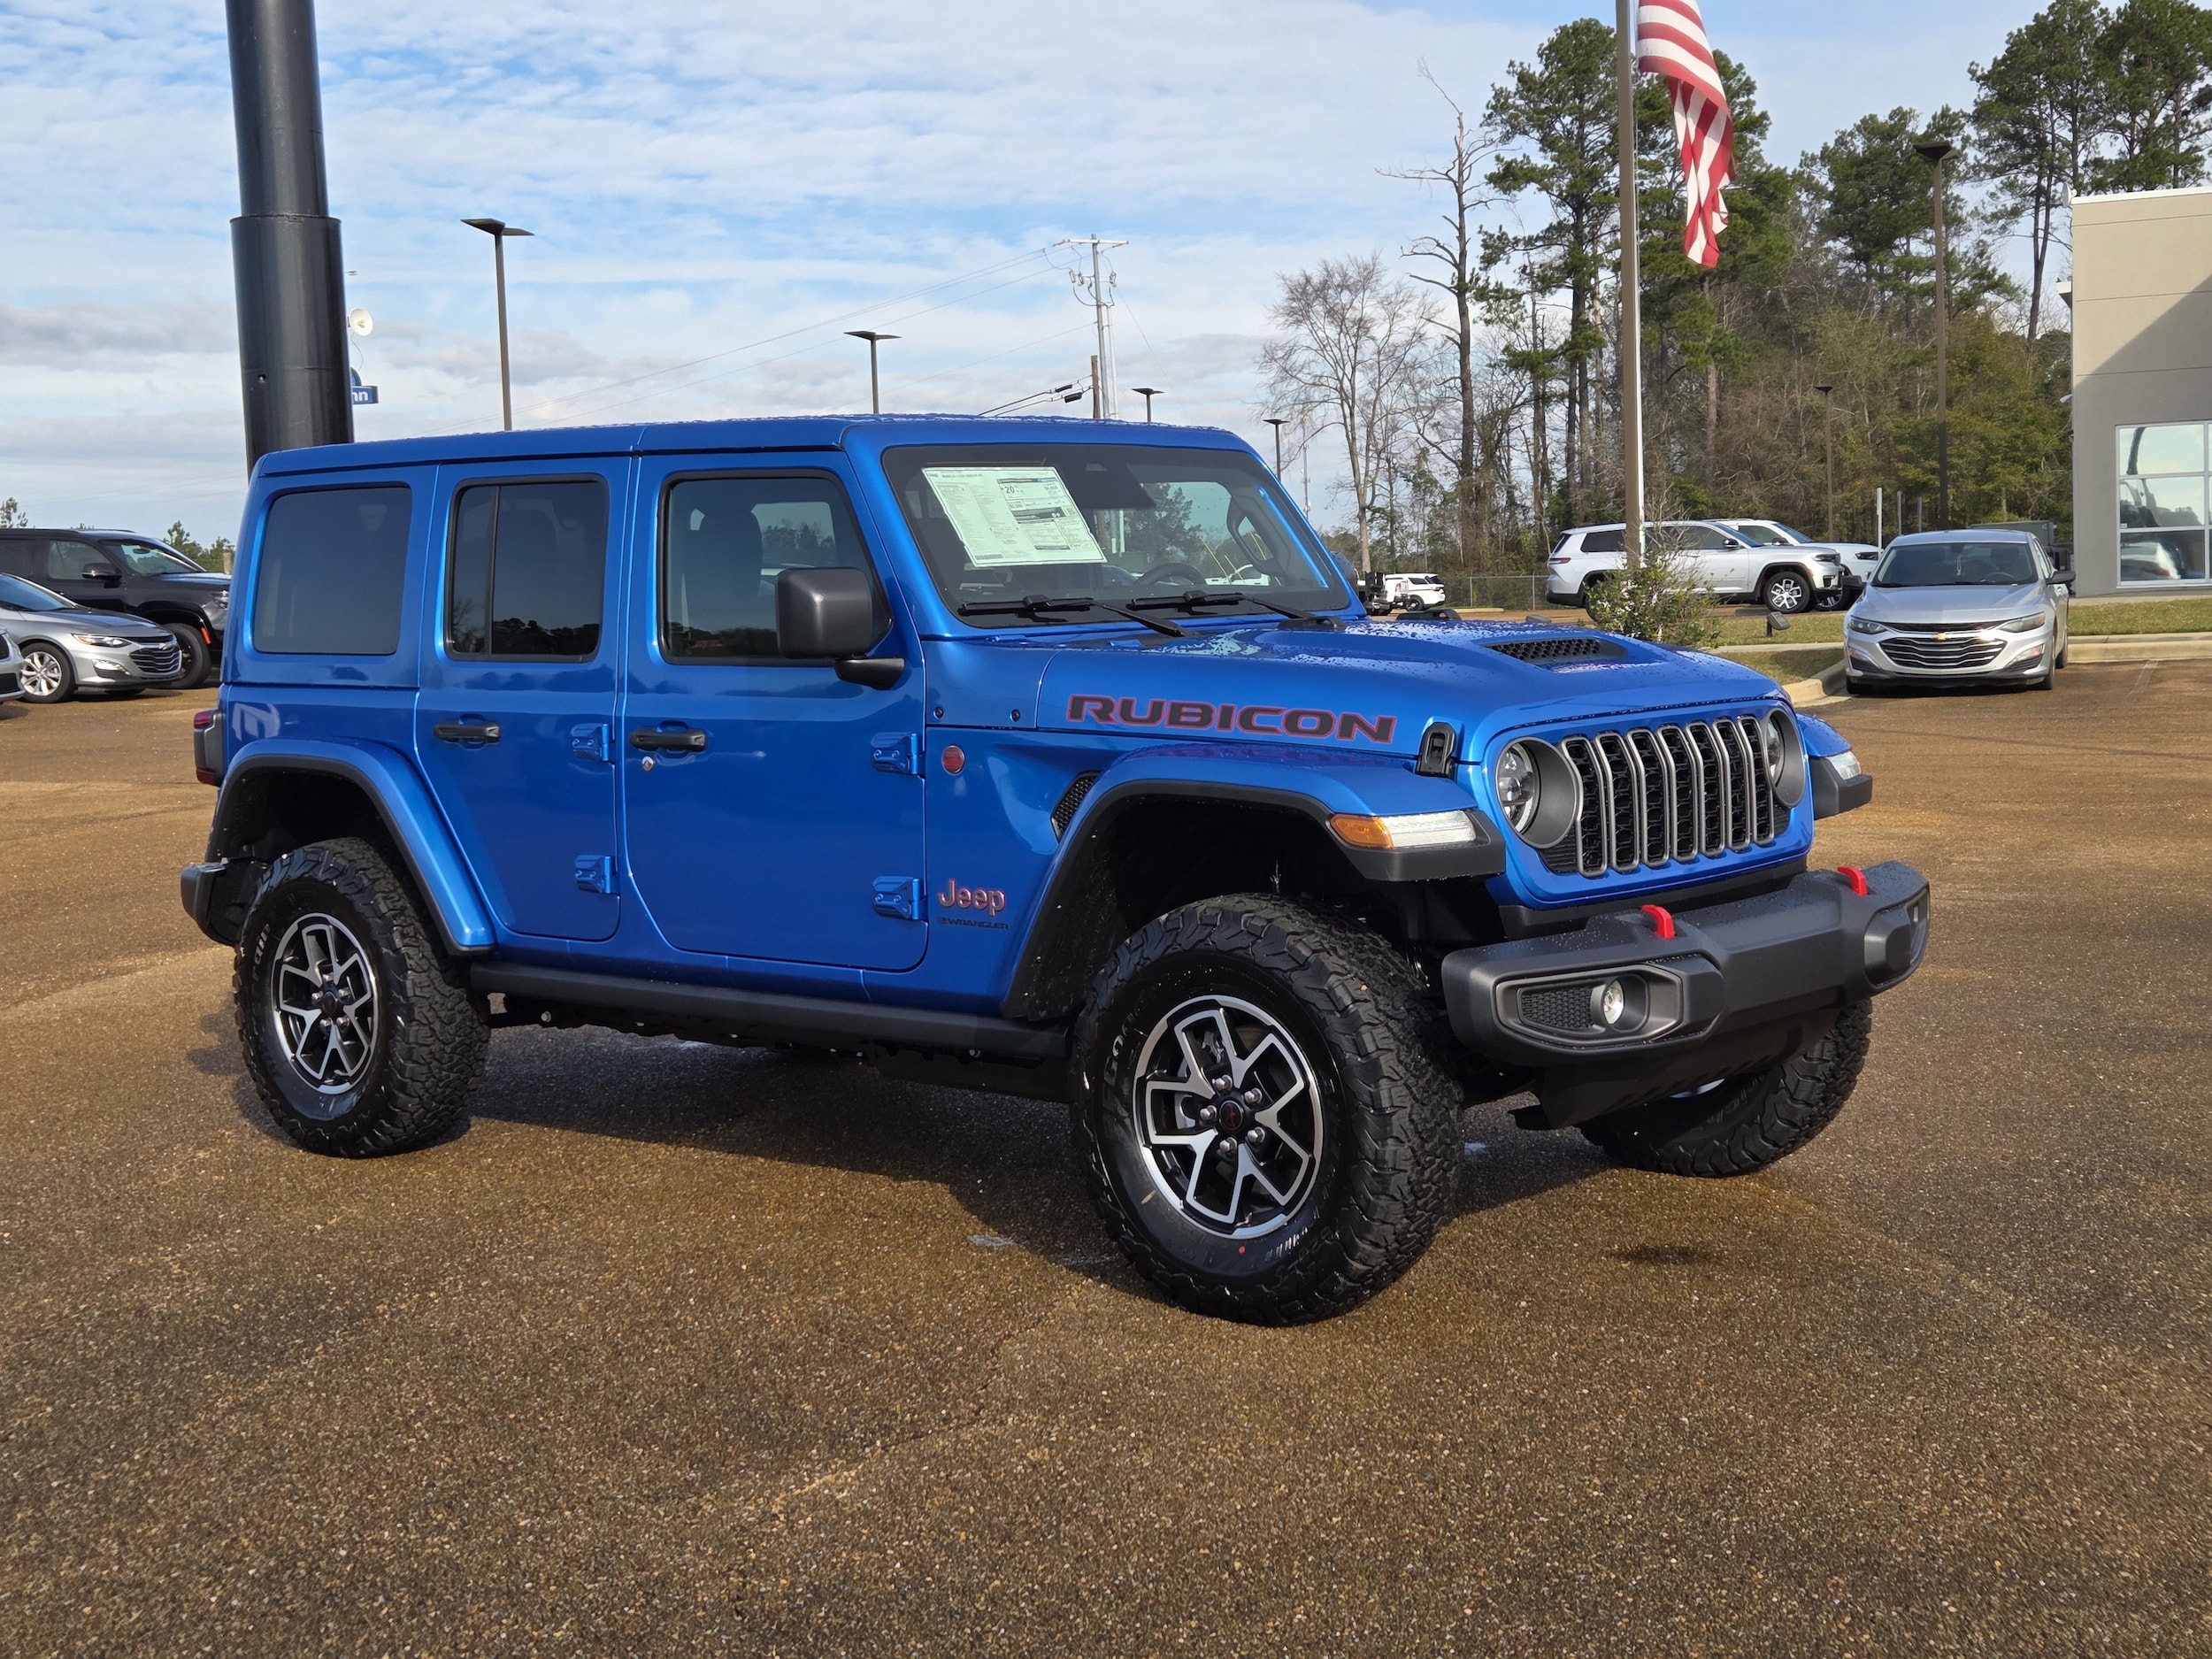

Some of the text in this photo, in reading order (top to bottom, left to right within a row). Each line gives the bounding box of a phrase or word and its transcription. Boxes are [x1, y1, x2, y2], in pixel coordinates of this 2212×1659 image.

[1067, 695, 1396, 744] RUBICON
[938, 878, 1006, 918] Jeep
[948, 918, 1009, 930] WRANGLER
